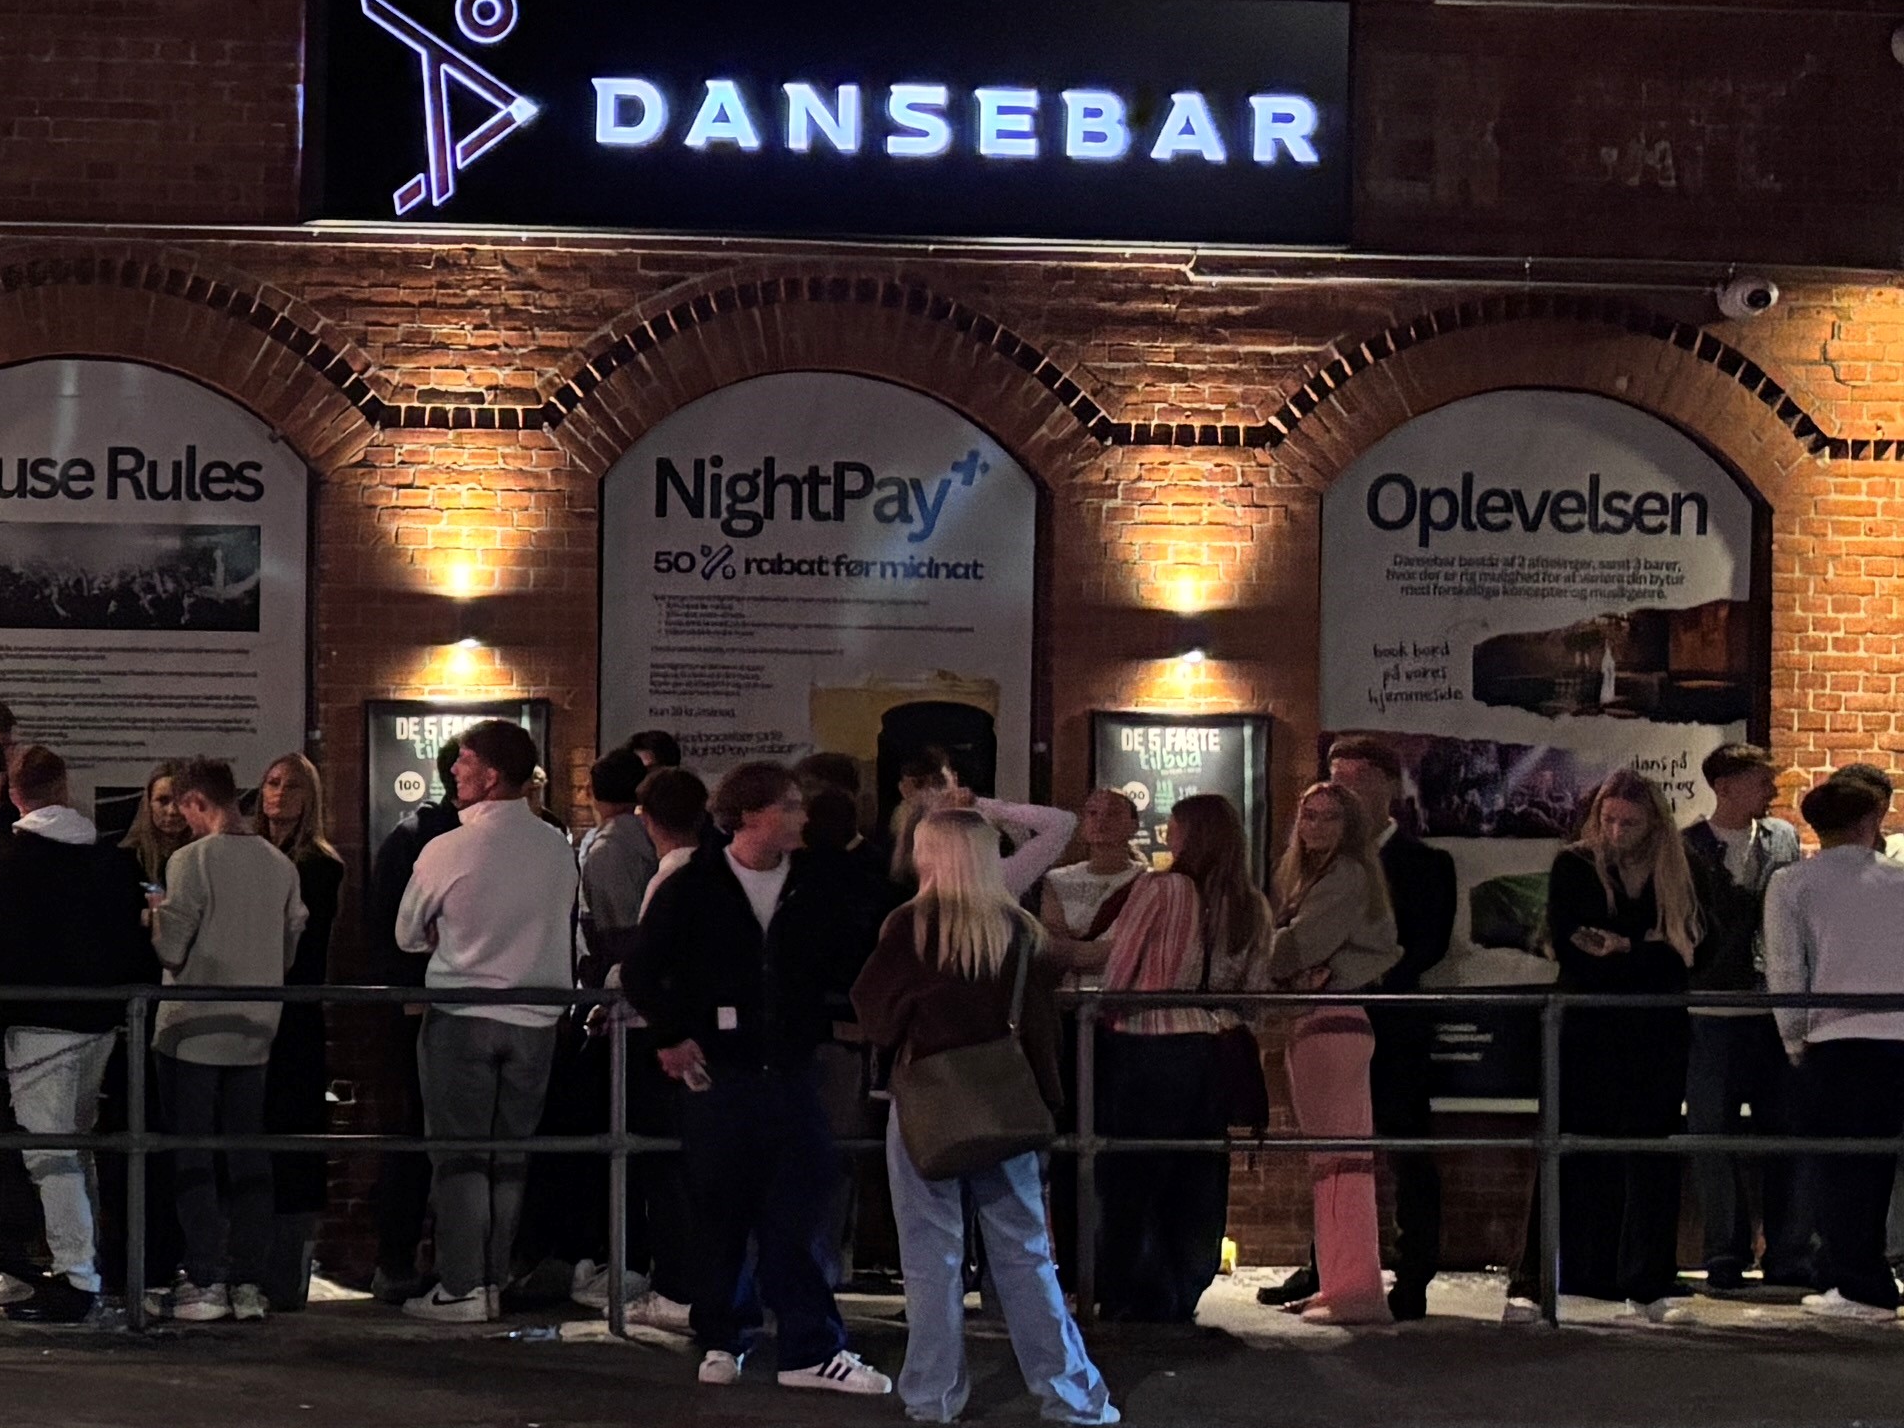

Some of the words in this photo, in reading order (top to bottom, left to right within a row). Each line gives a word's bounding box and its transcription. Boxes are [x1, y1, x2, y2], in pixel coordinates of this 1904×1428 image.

[591, 77, 1319, 165] DANSEBAR
[106, 444, 265, 503] Rules
[1366, 471, 1709, 549] Oplevelsen
[744, 552, 829, 577] rabat
[831, 553, 879, 578] før
[880, 554, 985, 580] midnat
[395, 716, 421, 741] DE
[423, 716, 439, 741] 5
[1121, 727, 1145, 751] DE
[1148, 727, 1162, 751] 5
[1165, 727, 1221, 752] FASTE
[398, 779, 421, 791] 100
